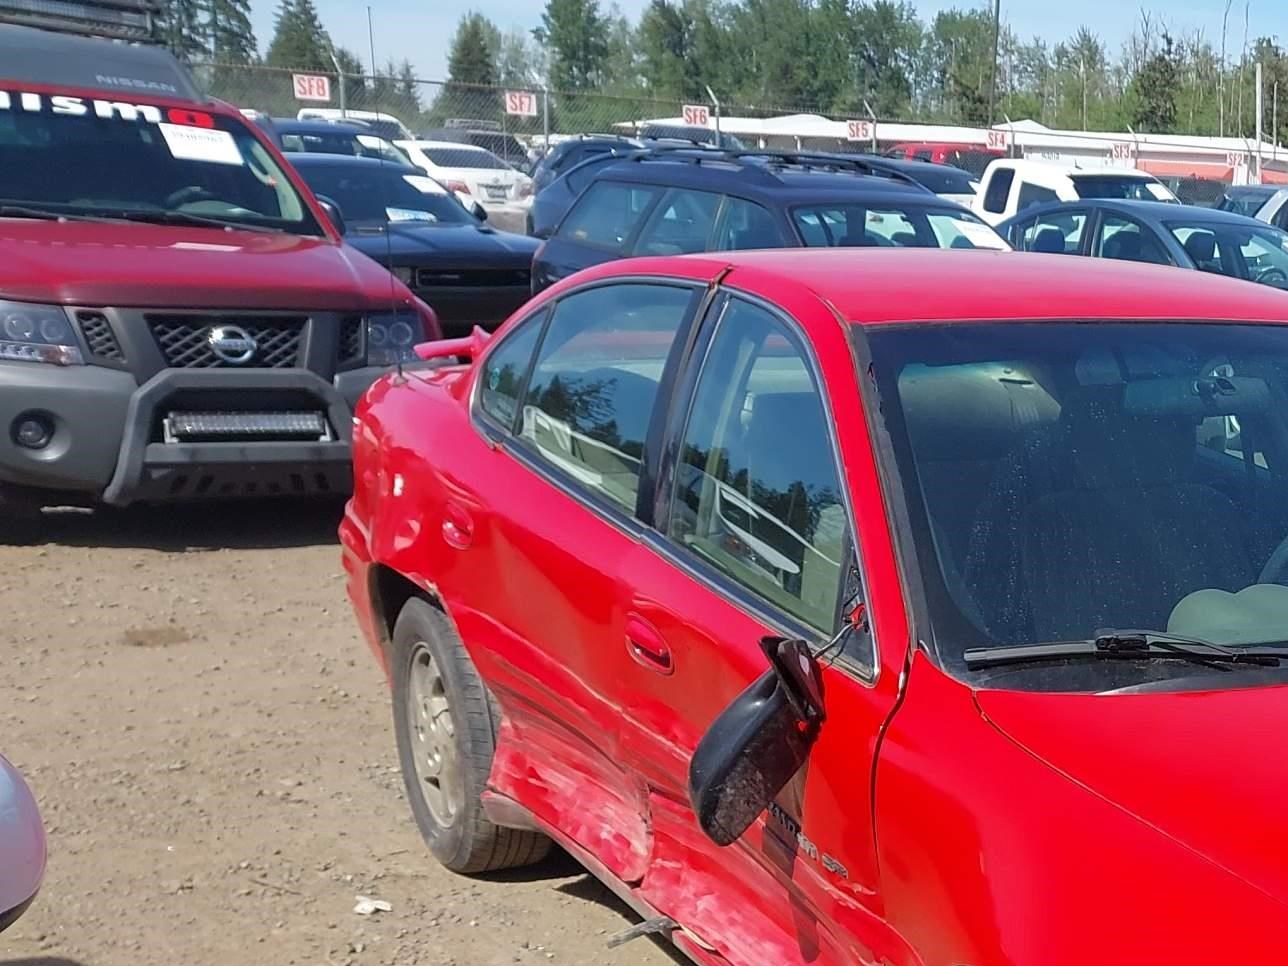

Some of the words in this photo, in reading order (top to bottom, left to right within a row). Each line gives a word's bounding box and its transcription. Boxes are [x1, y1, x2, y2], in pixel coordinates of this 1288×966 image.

[95, 74, 177, 93] NISSAN
[297, 76, 326, 98] SF8
[0, 90, 215, 128] ismo
[510, 94, 533, 113] SF7
[684, 108, 708, 125] SF6
[848, 122, 869, 138] SF5
[987, 131, 1006, 147] SF4
[1113, 143, 1131, 158] SF3
[1227, 152, 1243, 167] SF2
